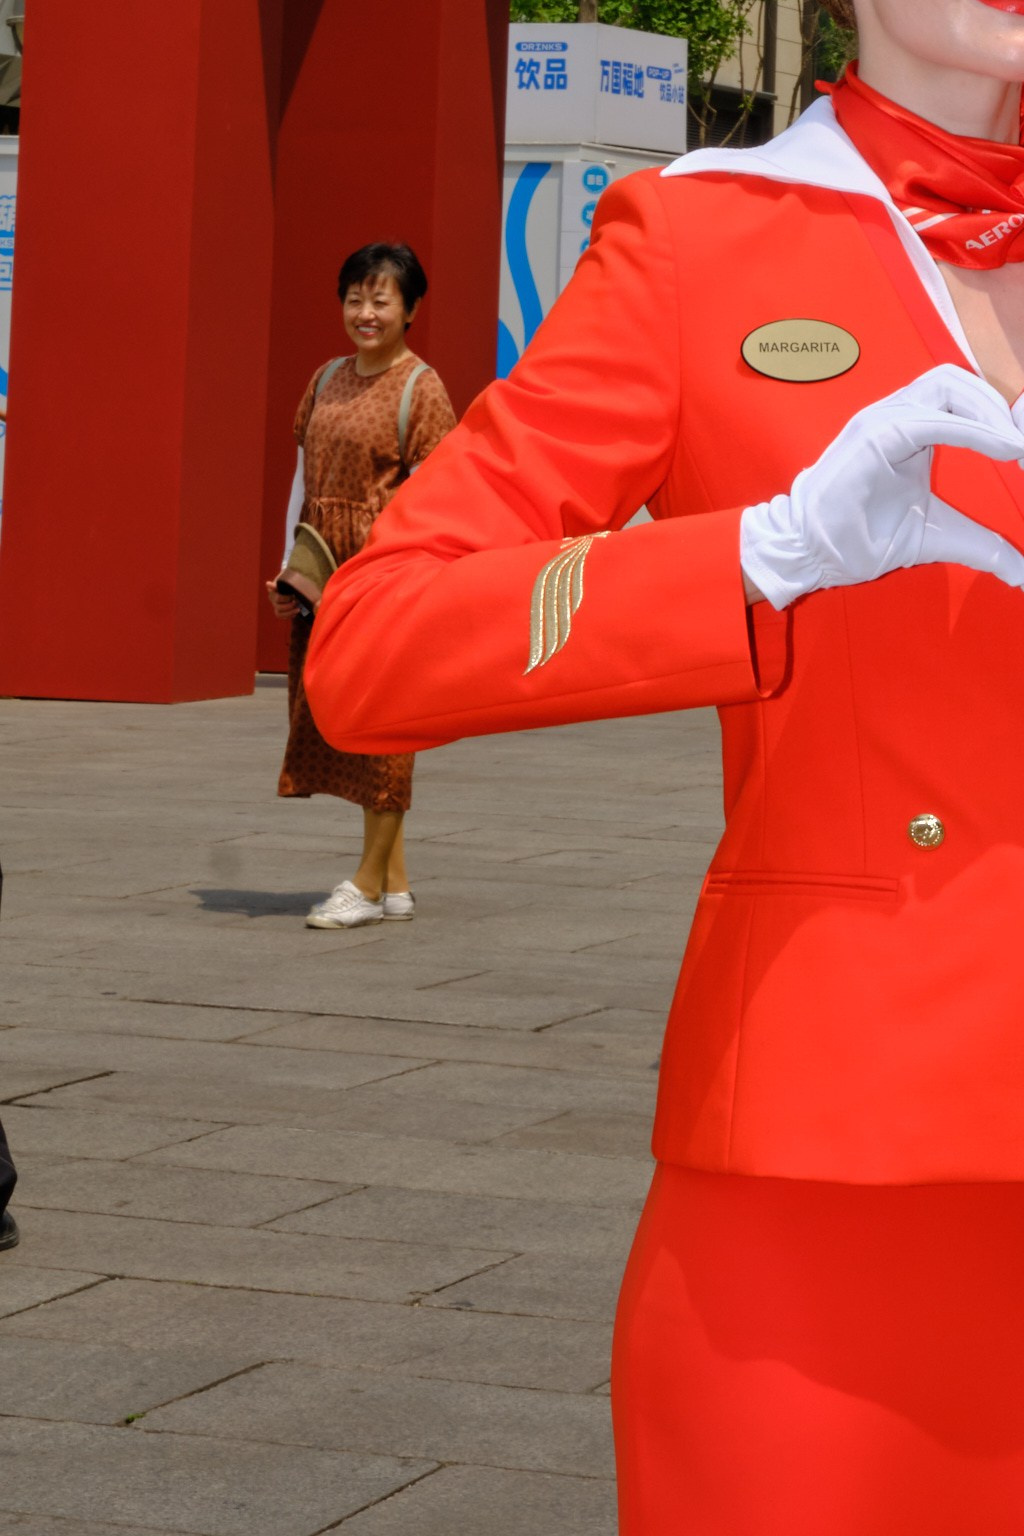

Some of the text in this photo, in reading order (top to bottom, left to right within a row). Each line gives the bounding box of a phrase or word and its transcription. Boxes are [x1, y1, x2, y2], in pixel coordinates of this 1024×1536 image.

[521, 42, 562, 51] DRINKS
[515, 58, 568, 90] 饮品
[600, 60, 644, 98] 万国福地
[660, 82, 684, 104] 饮品小站
[759, 342, 840, 353] MARGARITA
